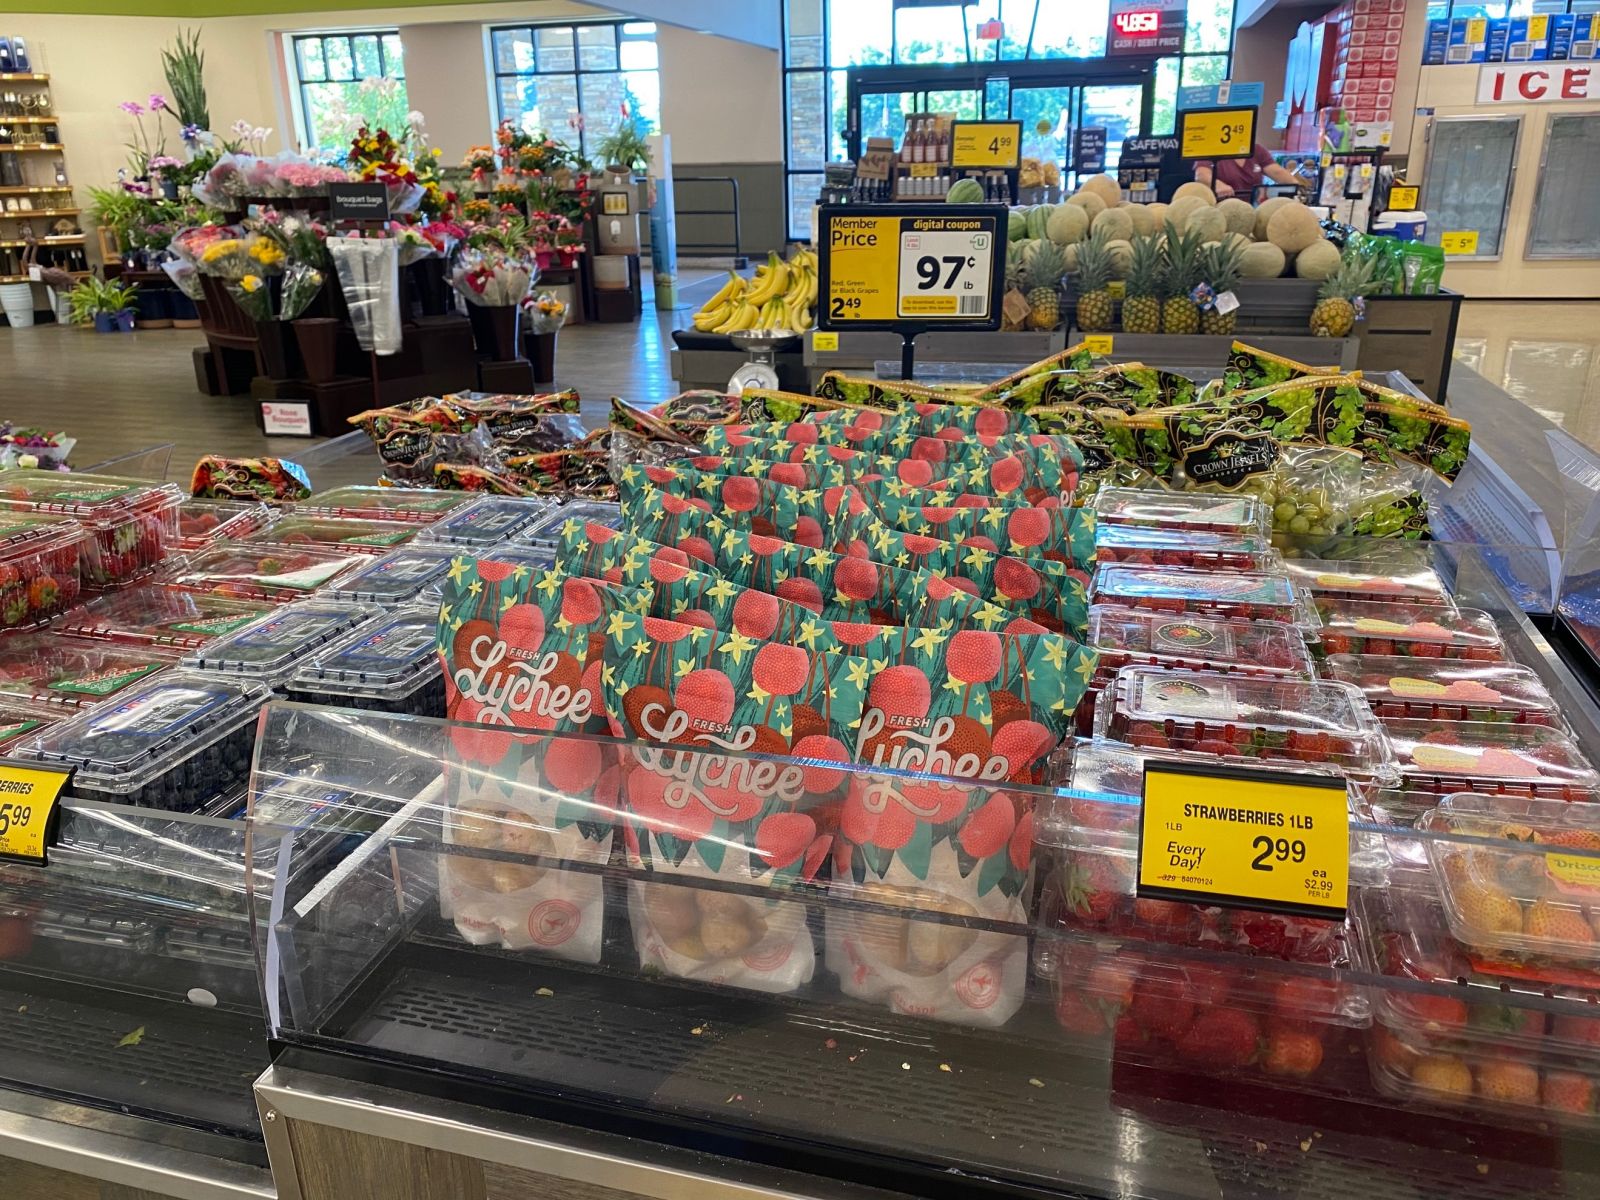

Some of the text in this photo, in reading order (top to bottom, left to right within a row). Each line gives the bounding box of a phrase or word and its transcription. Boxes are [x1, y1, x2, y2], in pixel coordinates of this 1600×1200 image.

[1138, 38, 1157, 47] DEBIT
[1159, 37, 1179, 46] PRICE
[1493, 67, 1591, 100] ICE
[1130, 138, 1179, 150] SAFEWAY
[832, 218, 877, 229] Member
[913, 219, 981, 231] digital coupon
[832, 230, 877, 246] Price
[964, 281, 973, 289] lb
[1193, 460, 1229, 475] CROWN
[509, 647, 542, 661] FRESH
[454, 634, 593, 737] Lychee
[693, 719, 733, 734] FRESH
[890, 715, 931, 728] FRESH
[632, 702, 805, 816] Lychee
[0, 780, 34, 795] ERRIES
[1184, 803, 1313, 830] STRAWBERRIES 1LB
[1165, 821, 1183, 832] 1LB
[1167, 841, 1206, 858] Every
[1169, 854, 1202, 871] Day!
[1312, 869, 1327, 878] ea
[1304, 878, 1333, 892] $2.99
[1308, 890, 1330, 899] PER LB
